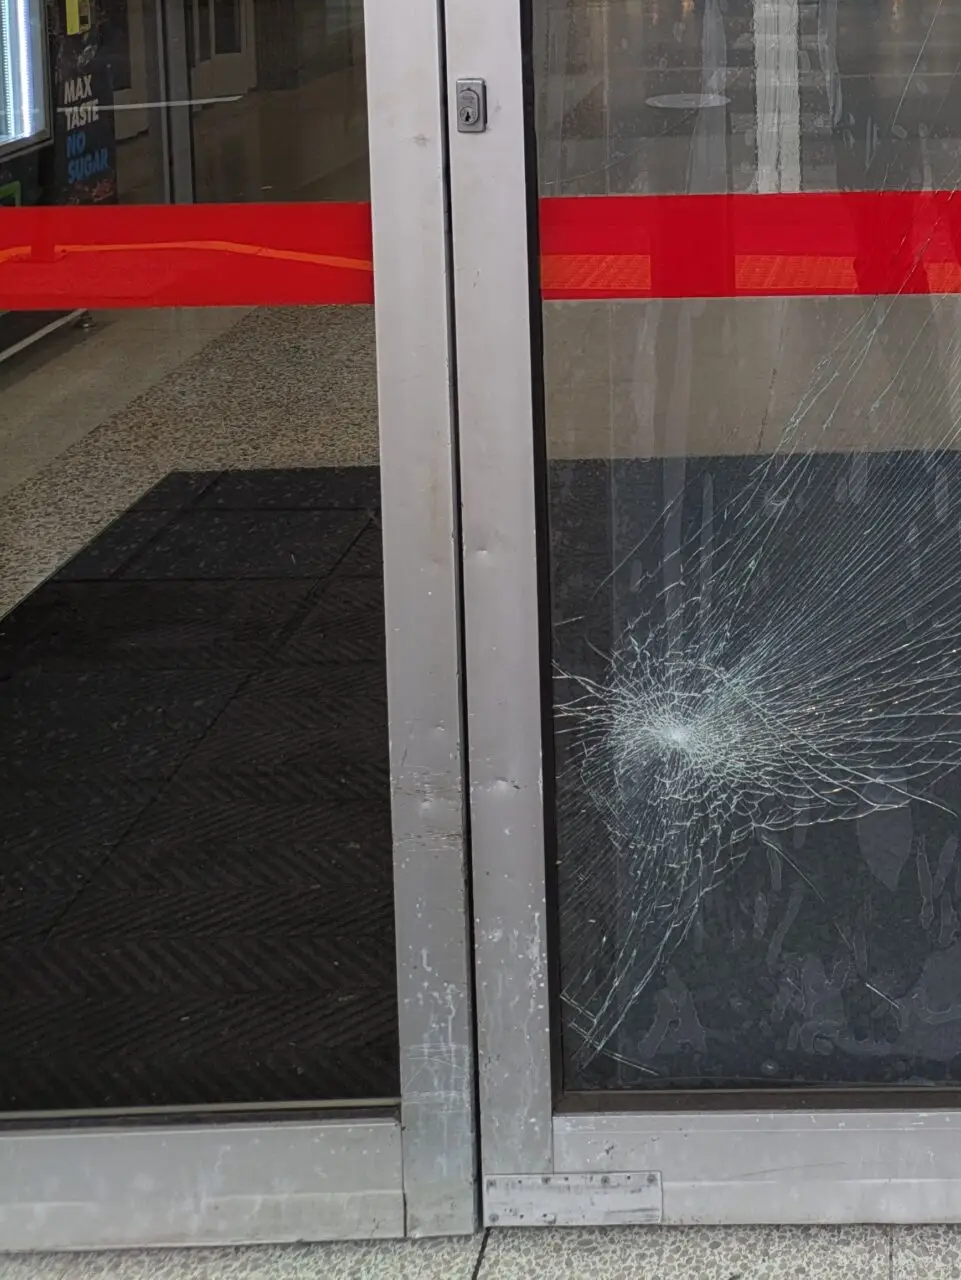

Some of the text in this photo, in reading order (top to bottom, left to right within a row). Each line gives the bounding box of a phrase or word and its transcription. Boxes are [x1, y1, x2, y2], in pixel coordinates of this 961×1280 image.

[64, 74, 92, 105] MAX
[64, 98, 100, 132] TASTE
[67, 131, 86, 159] NO
[68, 146, 109, 185] SUGAR
